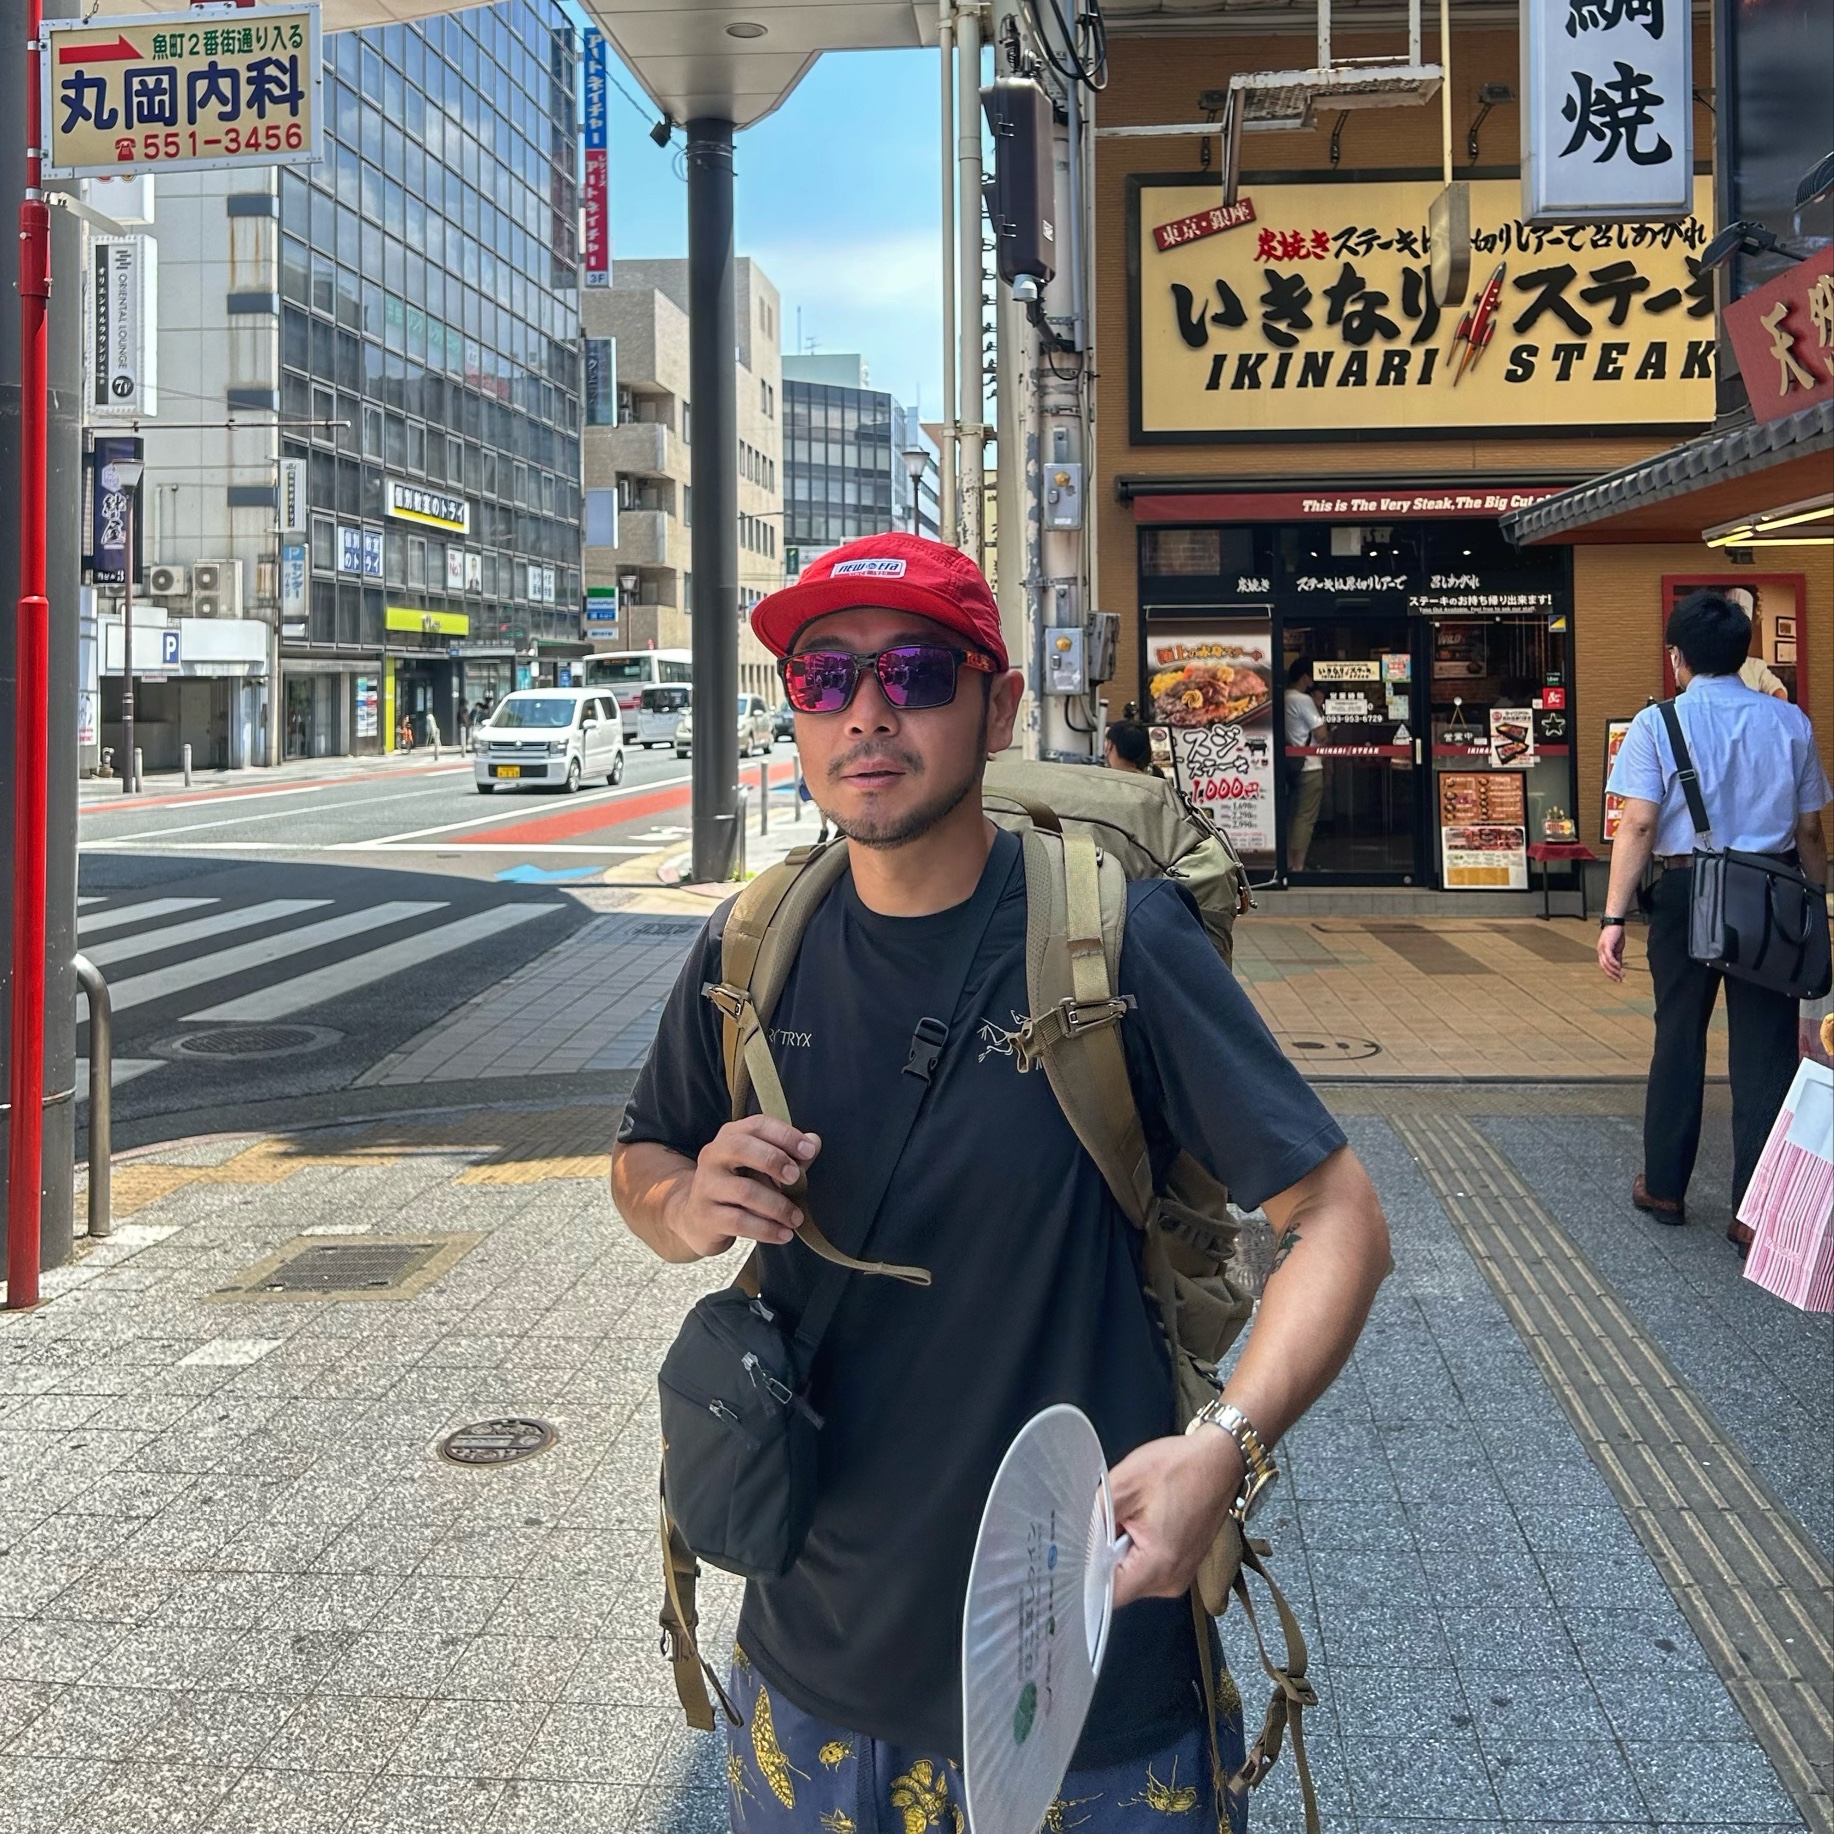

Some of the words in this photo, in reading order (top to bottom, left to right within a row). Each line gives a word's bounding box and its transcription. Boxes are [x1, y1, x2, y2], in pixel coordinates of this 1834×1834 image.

[152, 24, 303, 60] 魚町2番街通り入る
[61, 54, 304, 133] 丸岡内科
[144, 123, 302, 159] 551-3456
[1160, 201, 1251, 246] 東京・銀座
[590, 272, 606, 284] 3F
[118, 272, 128, 322] ORIENTAL
[1170, 261, 1441, 348] いきなり
[118, 325, 128, 370] LOUNGE
[1205, 348, 1440, 391] IKINARI
[1504, 340, 1716, 383] STEAK
[1302, 499, 1333, 512] This
[1334, 498, 1348, 512] is
[1350, 498, 1378, 512] The
[1380, 497, 1412, 513] Very
[1484, 495, 1509, 511] Big
[1510, 494, 1534, 508] Cut
[288, 547, 300, 561] P
[1236, 576, 1270, 592] 炭焼き
[1430, 573, 1480, 590] 召しあがれ
[1409, 594, 1553, 607] ステーキのお持ち帰り出来ます!
[166, 635, 177, 660] P
[1187, 756, 1249, 779] ステーキ
